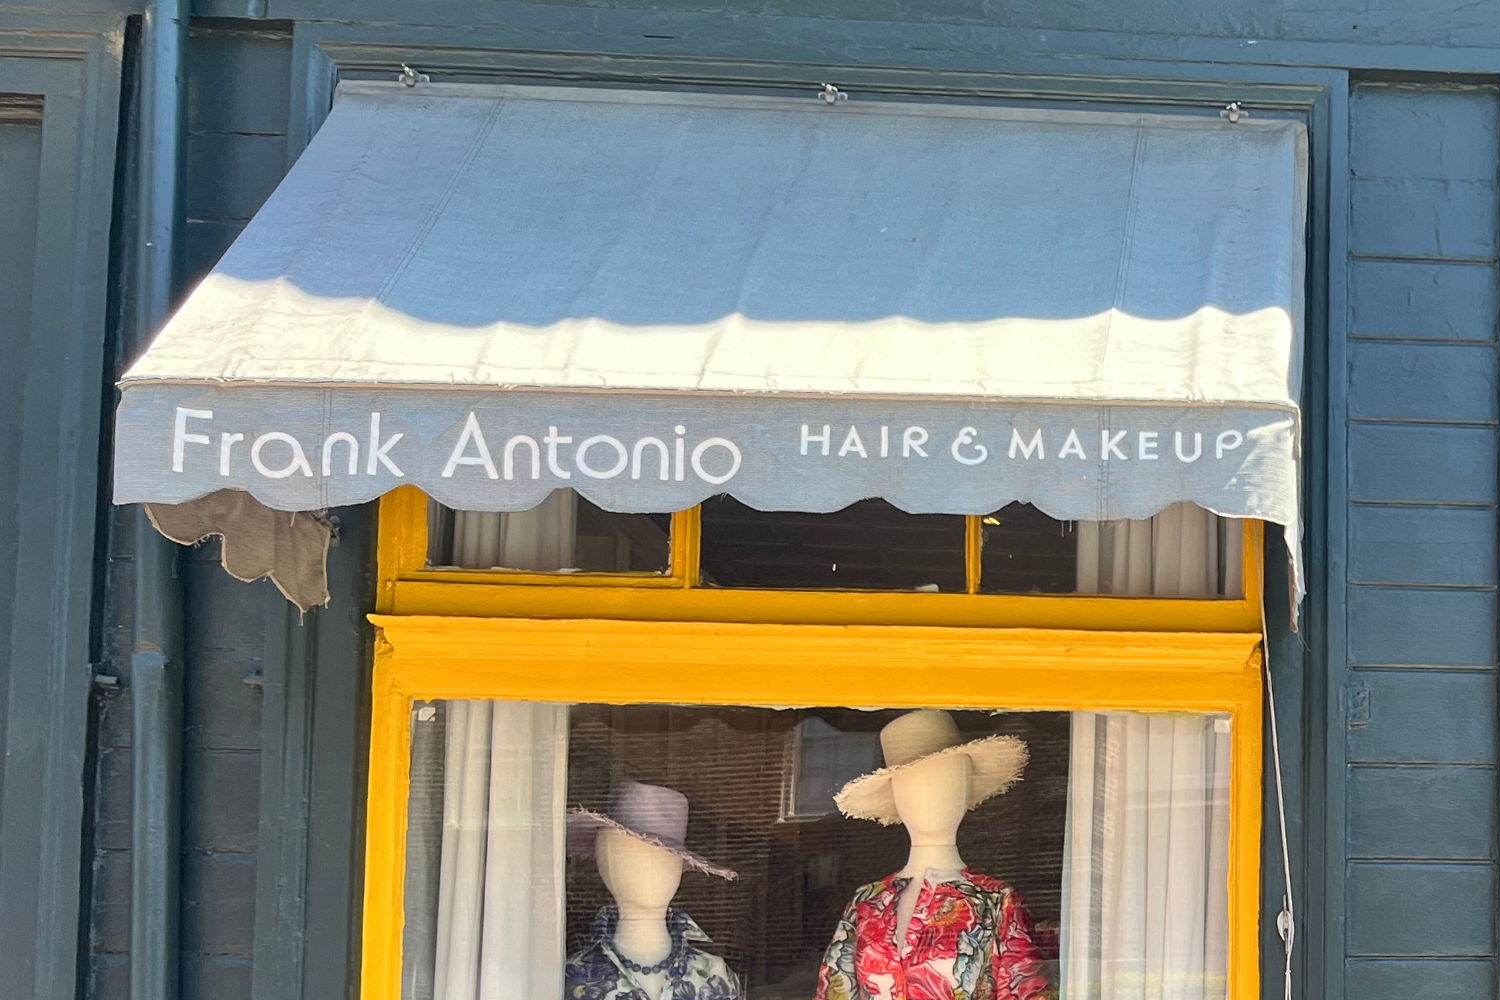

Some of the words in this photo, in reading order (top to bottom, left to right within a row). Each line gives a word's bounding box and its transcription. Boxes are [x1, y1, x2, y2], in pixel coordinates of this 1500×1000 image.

[171, 406, 404, 479] Frank
[441, 410, 742, 485] Antonio
[800, 424, 930, 459] HAIR
[950, 426, 989, 466] &
[1008, 427, 1244, 463] MAKEUP
